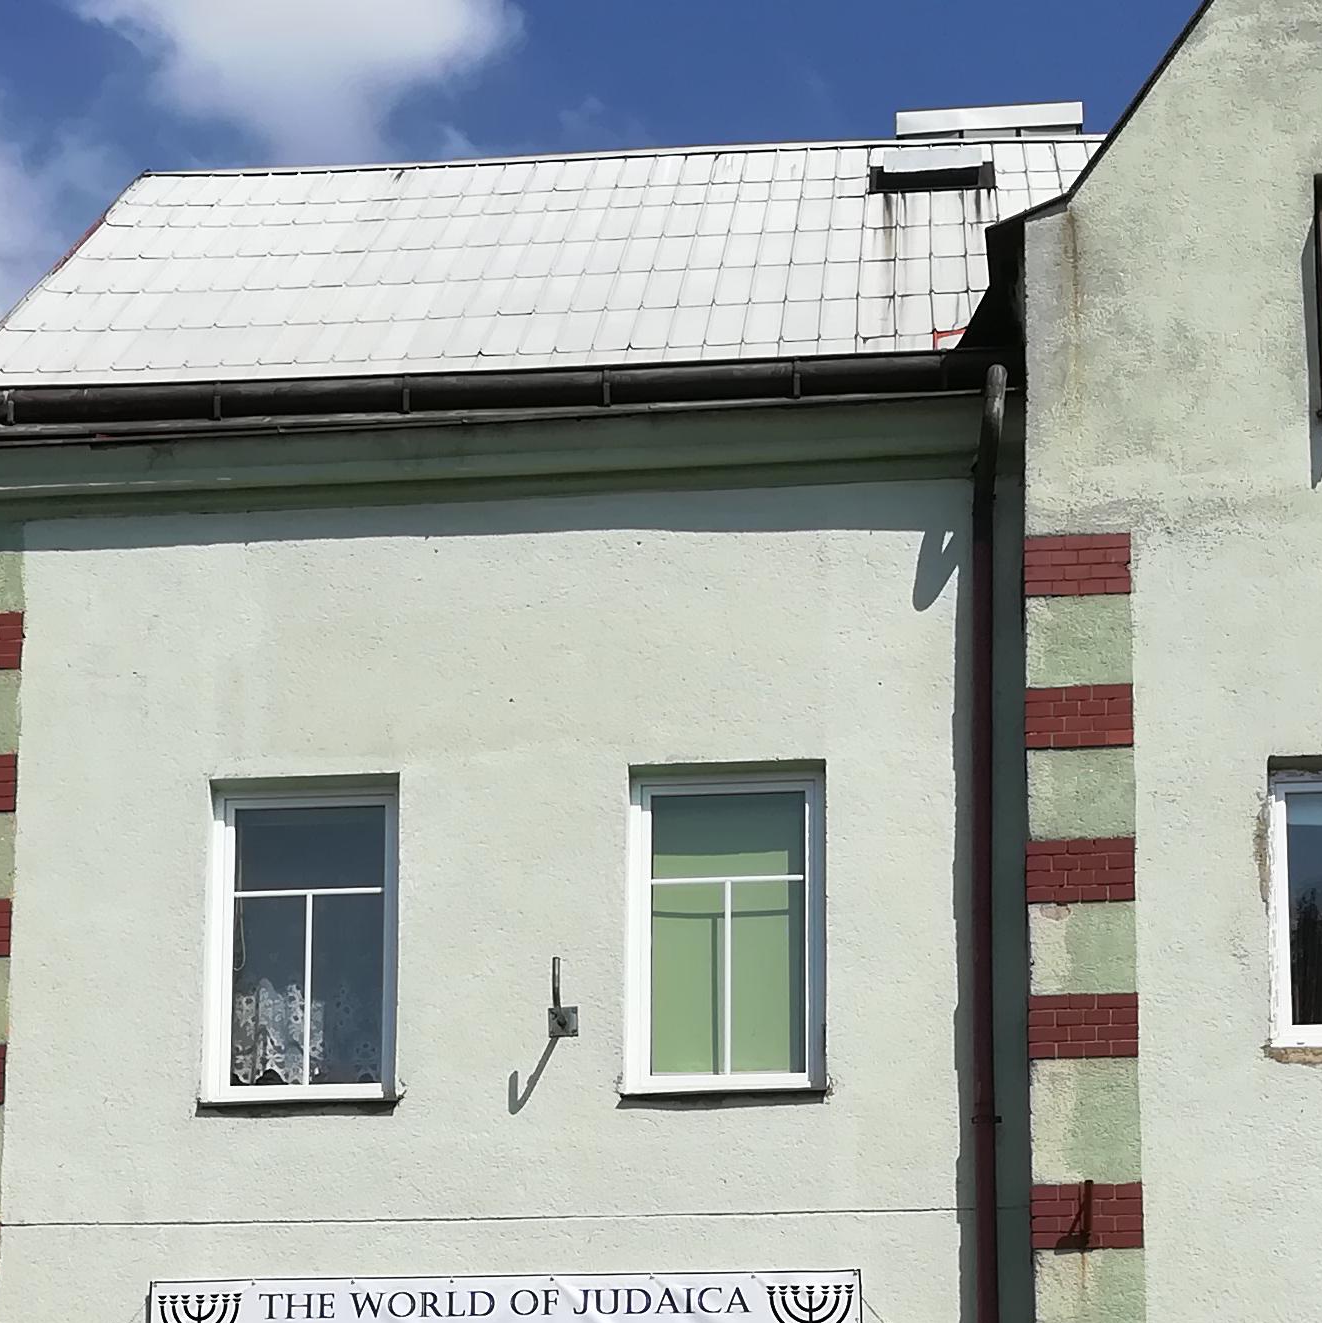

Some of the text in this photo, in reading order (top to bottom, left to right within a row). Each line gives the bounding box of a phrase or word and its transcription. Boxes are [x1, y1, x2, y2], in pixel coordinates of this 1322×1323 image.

[258, 1286, 752, 1320] THE WORLD OF JUDAICA
